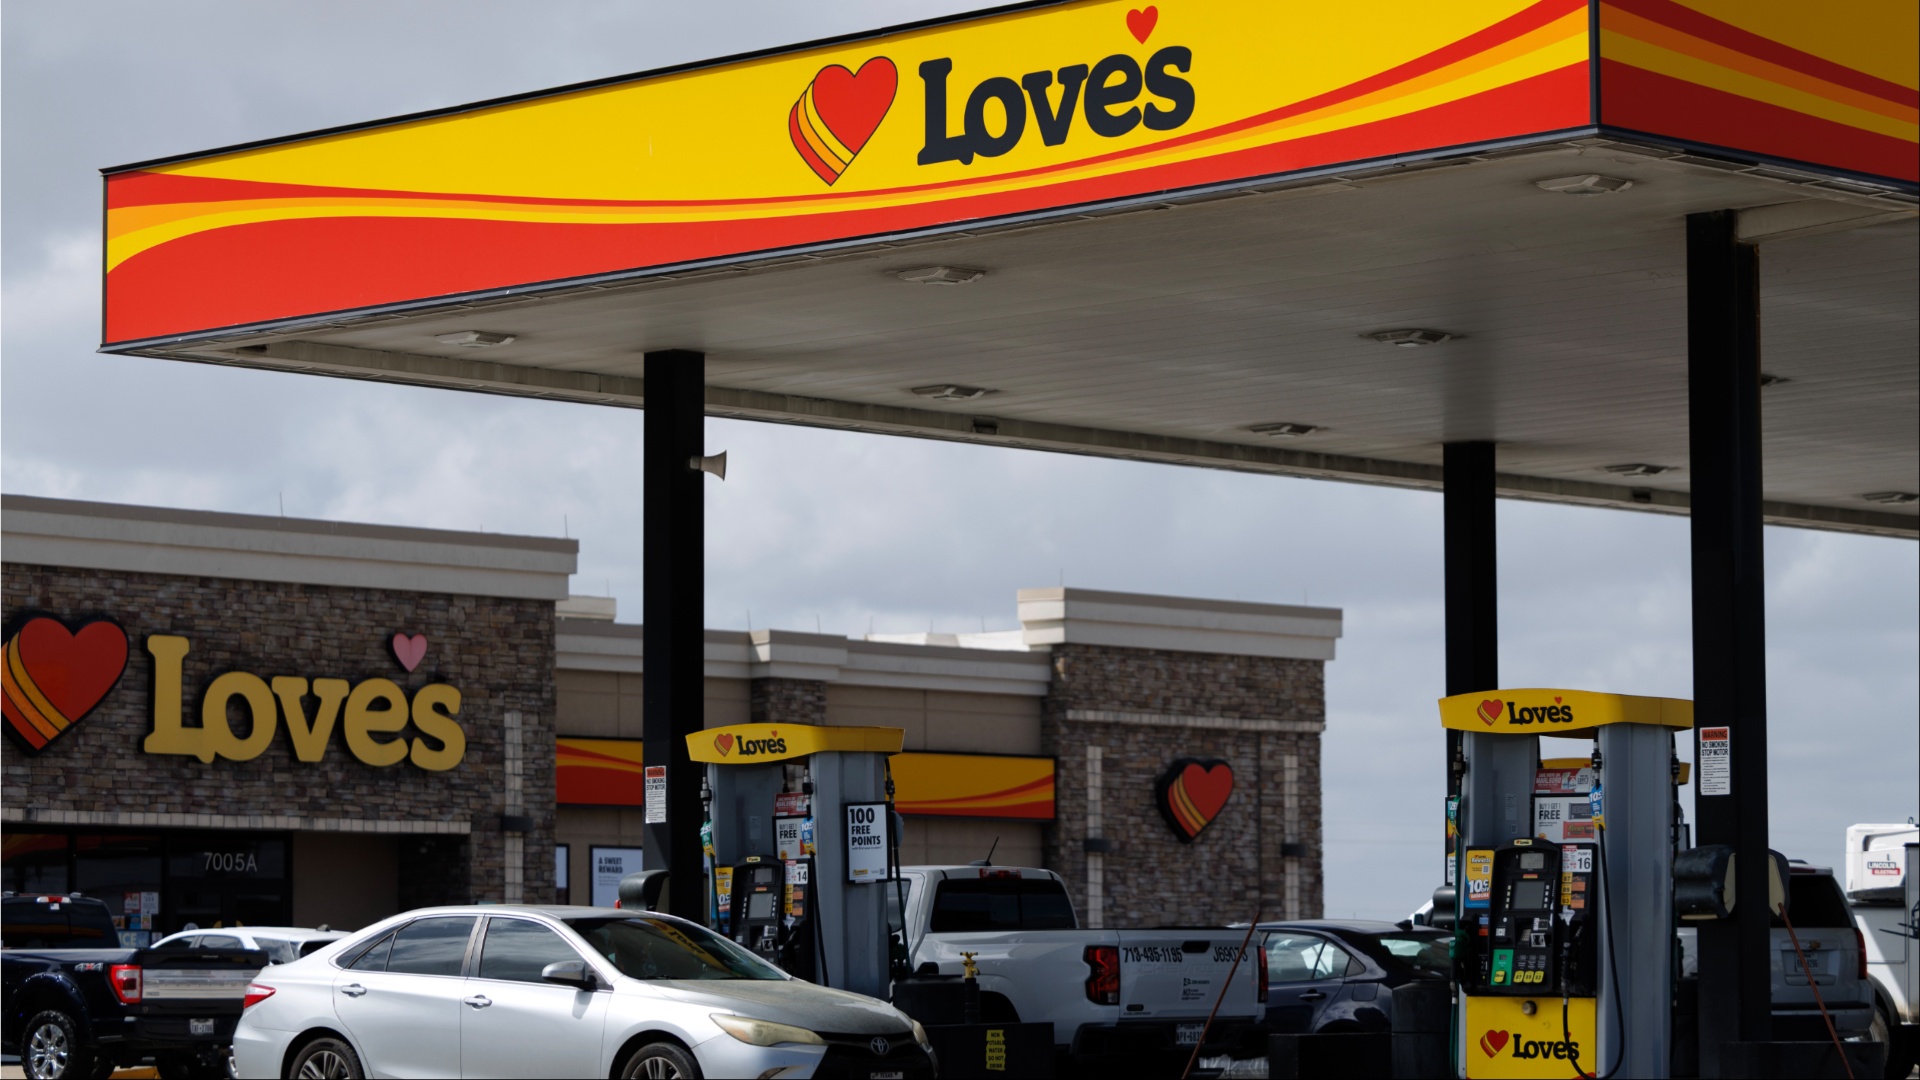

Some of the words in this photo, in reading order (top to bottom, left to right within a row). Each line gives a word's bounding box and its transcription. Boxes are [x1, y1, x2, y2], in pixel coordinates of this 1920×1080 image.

[1702, 730, 1728, 739] WARNING
[850, 808, 875, 824] 100
[1539, 810, 1561, 819] FREE
[780, 830, 797, 839] FREE
[852, 826, 871, 835] FREE
[852, 836, 881, 846] POINTS
[203, 852, 258, 872] 7005A
[1578, 858, 1591, 869] 16
[798, 871, 807, 881] 14
[1123, 947, 1183, 962] 713-435-1195
